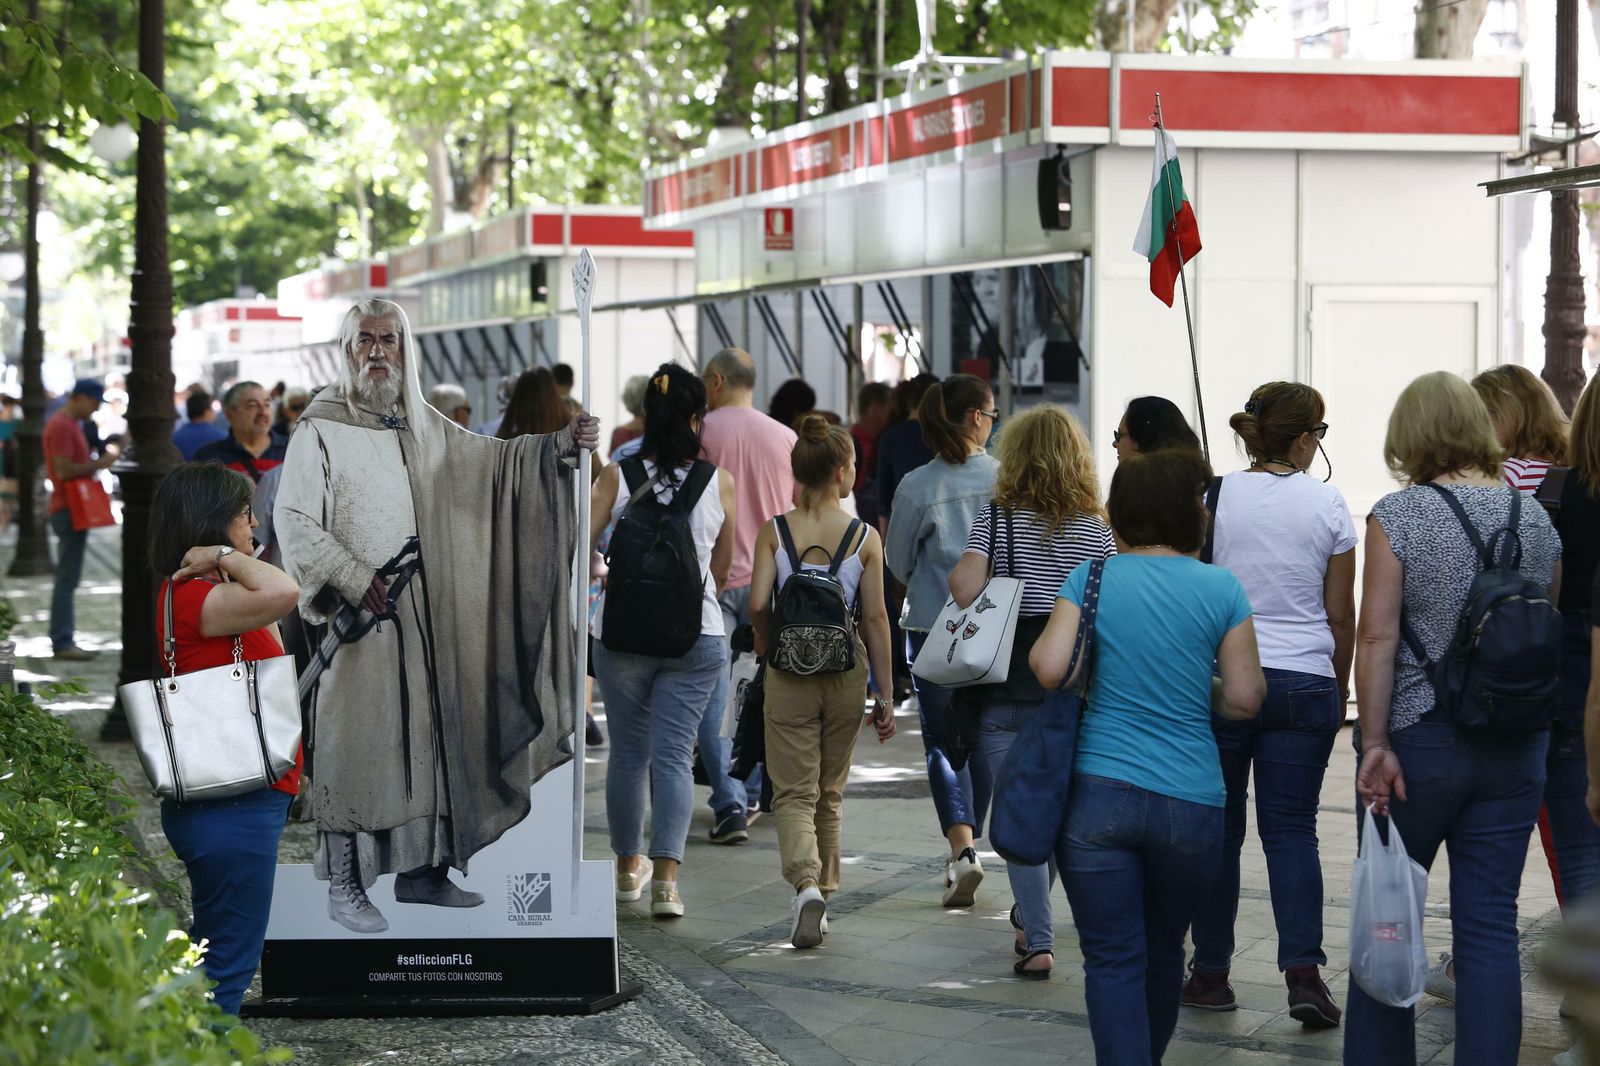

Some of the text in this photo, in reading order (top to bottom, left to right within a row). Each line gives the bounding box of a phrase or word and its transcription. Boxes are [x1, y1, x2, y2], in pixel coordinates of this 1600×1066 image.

[397, 953, 473, 966] #selficcionFLG
[368, 972, 503, 982] COMPARTE TUS FOTOS CON NOSOTROS
